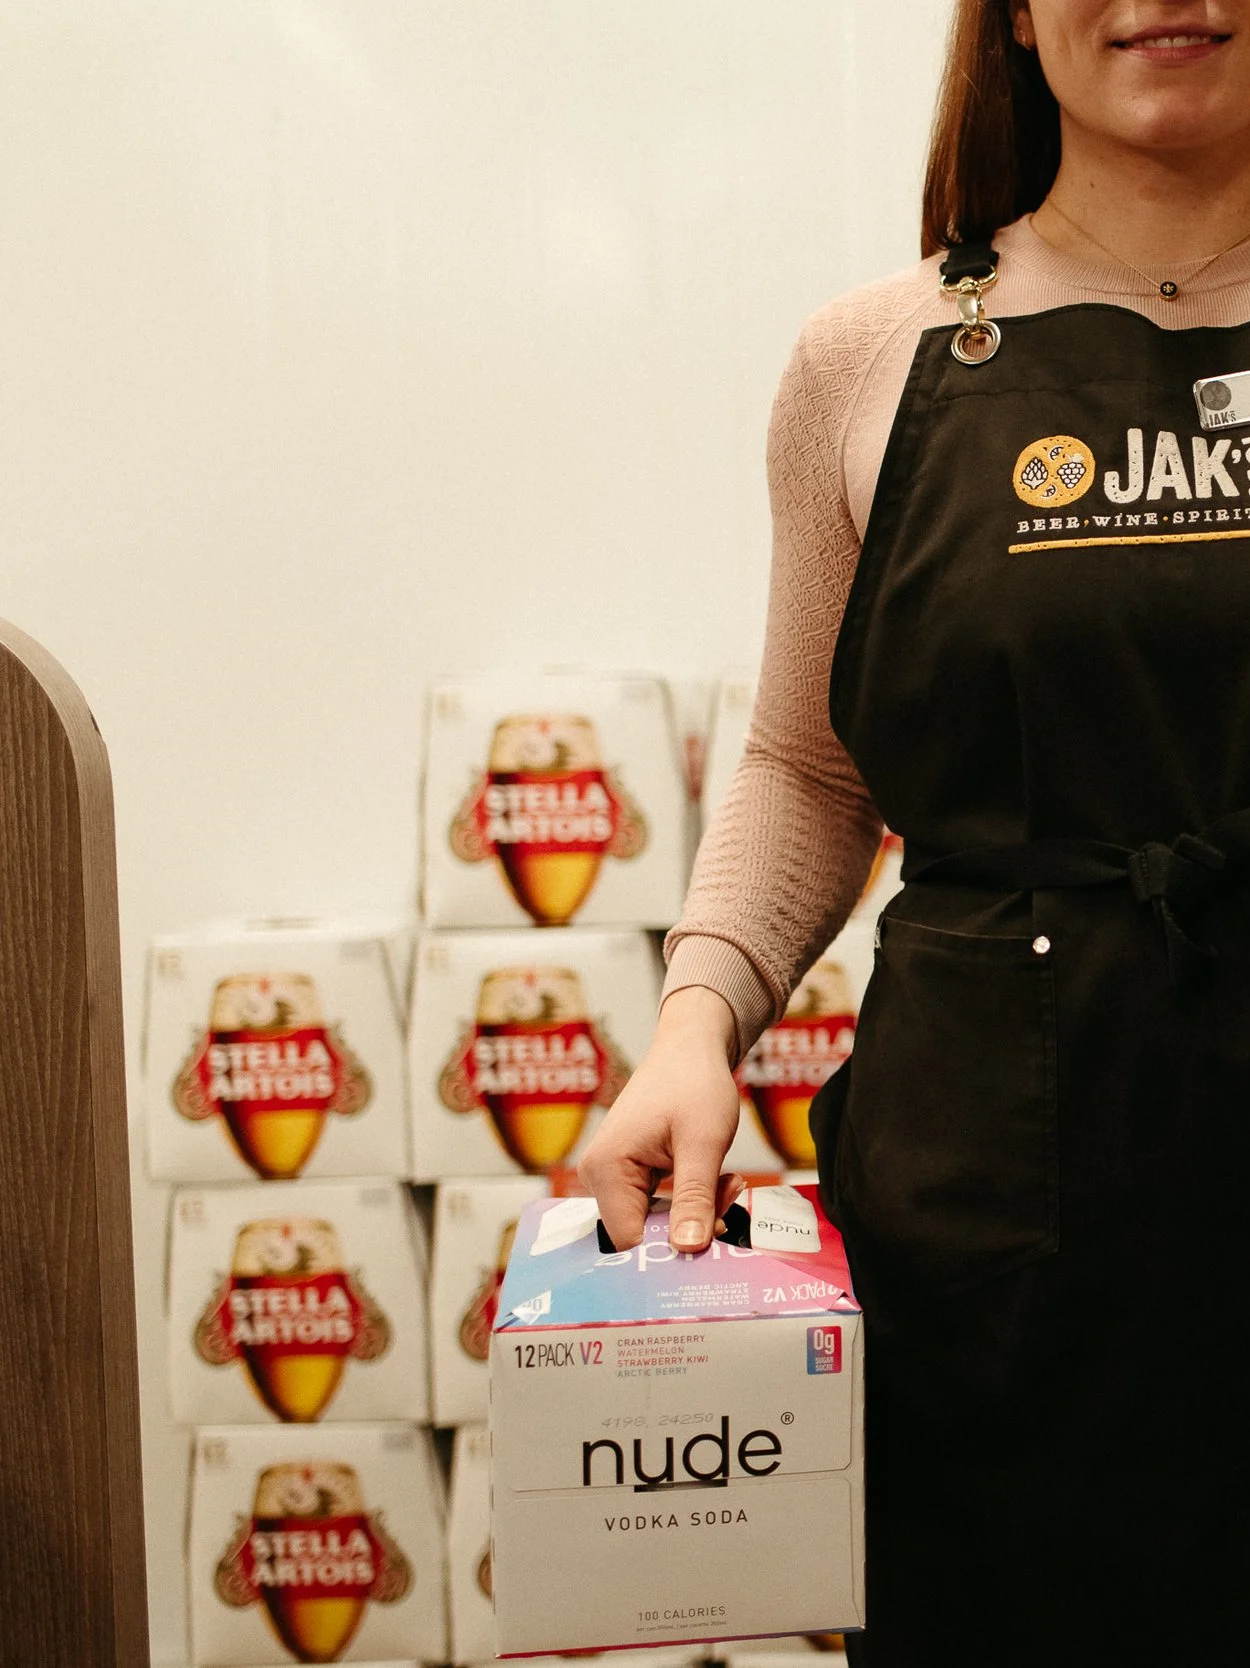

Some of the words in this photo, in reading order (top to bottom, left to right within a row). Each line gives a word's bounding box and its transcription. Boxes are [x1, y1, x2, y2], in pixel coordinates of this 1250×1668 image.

[1016, 518, 1080, 533] BEER
[1095, 513, 1159, 527] WINE
[486, 783, 611, 812] STELLA
[487, 814, 612, 843] ARTOIS
[209, 1039, 331, 1067] STELLA
[473, 1032, 597, 1063] STELLA
[209, 1073, 335, 1101] ARTOIS
[474, 1065, 599, 1094] ARTOIS
[757, 1220, 812, 1237] nude
[228, 1286, 350, 1314] STELLA
[763, 1287, 787, 1303] V2
[230, 1319, 354, 1345] ARTOIS
[617, 1338, 644, 1347] CRAN
[647, 1335, 706, 1344] RASPBERRY
[813, 1329, 835, 1354] 0g
[579, 1341, 604, 1365] V2
[617, 1347, 685, 1357] WATERMELON
[617, 1357, 683, 1367] STRAWBERRY
[687, 1355, 709, 1364] KIWI
[617, 1369, 651, 1378] ARCTIC
[656, 1367, 688, 1376] BERRY
[582, 1415, 783, 1492] nude
[604, 1514, 679, 1532] VODKA
[690, 1509, 749, 1527] SODA
[251, 1530, 372, 1557] STELLA
[253, 1561, 375, 1587] ARTOIS
[638, 1611, 659, 1621] 100
[663, 1605, 727, 1620] CALORIES
